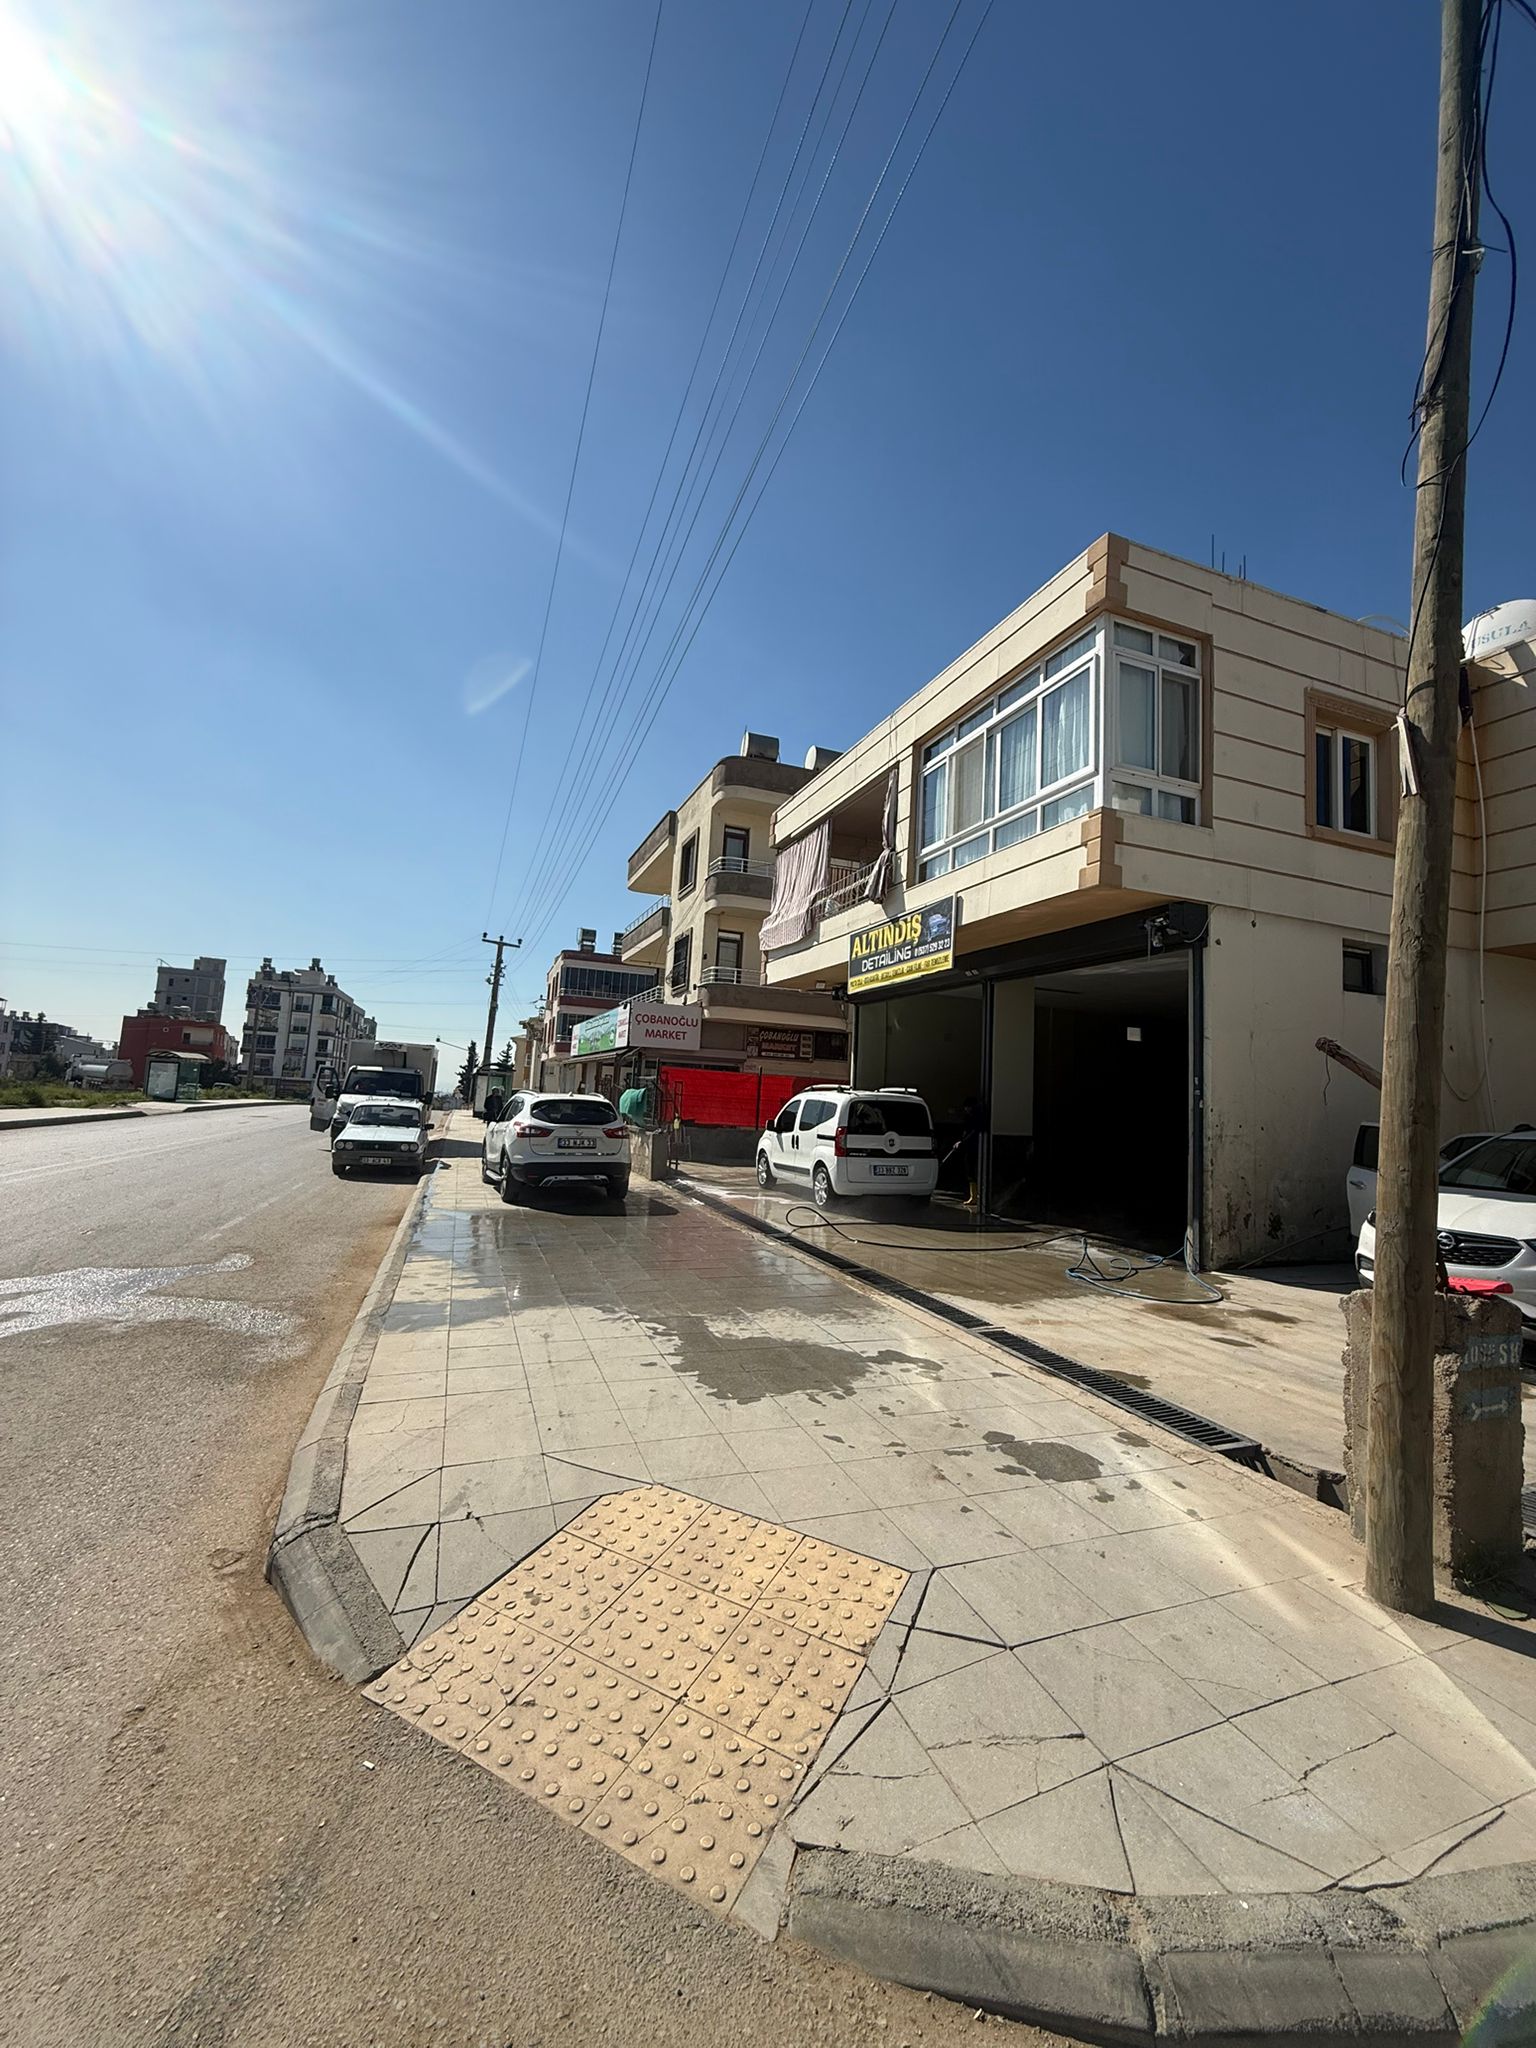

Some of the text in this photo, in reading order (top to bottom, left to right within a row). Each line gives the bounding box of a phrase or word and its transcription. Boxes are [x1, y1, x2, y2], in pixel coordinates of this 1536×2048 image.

[852, 914, 922, 958] ALTINDİŞ
[862, 946, 911, 972] DETAİLİNG
[635, 1013, 699, 1028] ÇOBANOĞLU
[645, 1029, 688, 1041] MARKET
